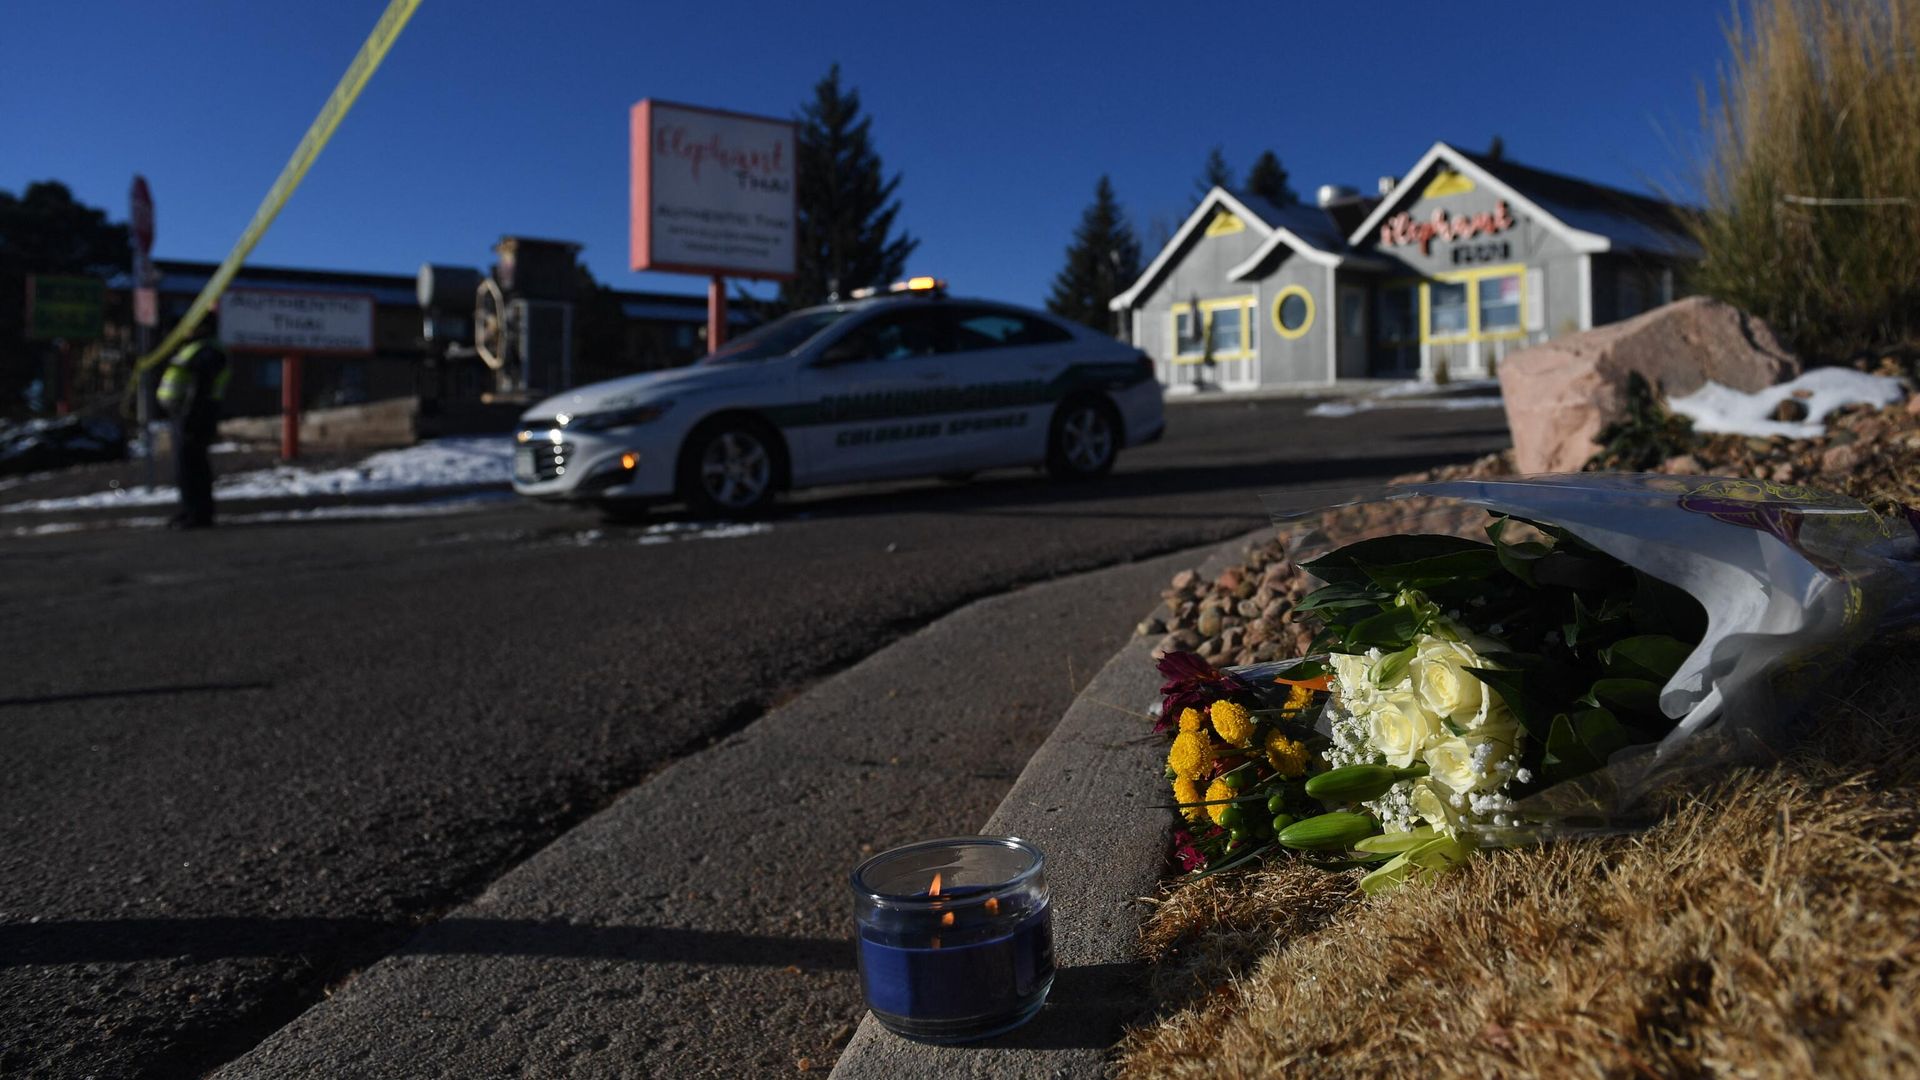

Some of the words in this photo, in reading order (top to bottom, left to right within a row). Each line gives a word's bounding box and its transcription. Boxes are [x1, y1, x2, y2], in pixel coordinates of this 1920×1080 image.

[656, 124, 785, 188] Elephant
[1380, 198, 1514, 256] Elephant
[835, 421, 942, 446] COLORADO
[946, 412, 1028, 436] SPRINGS
